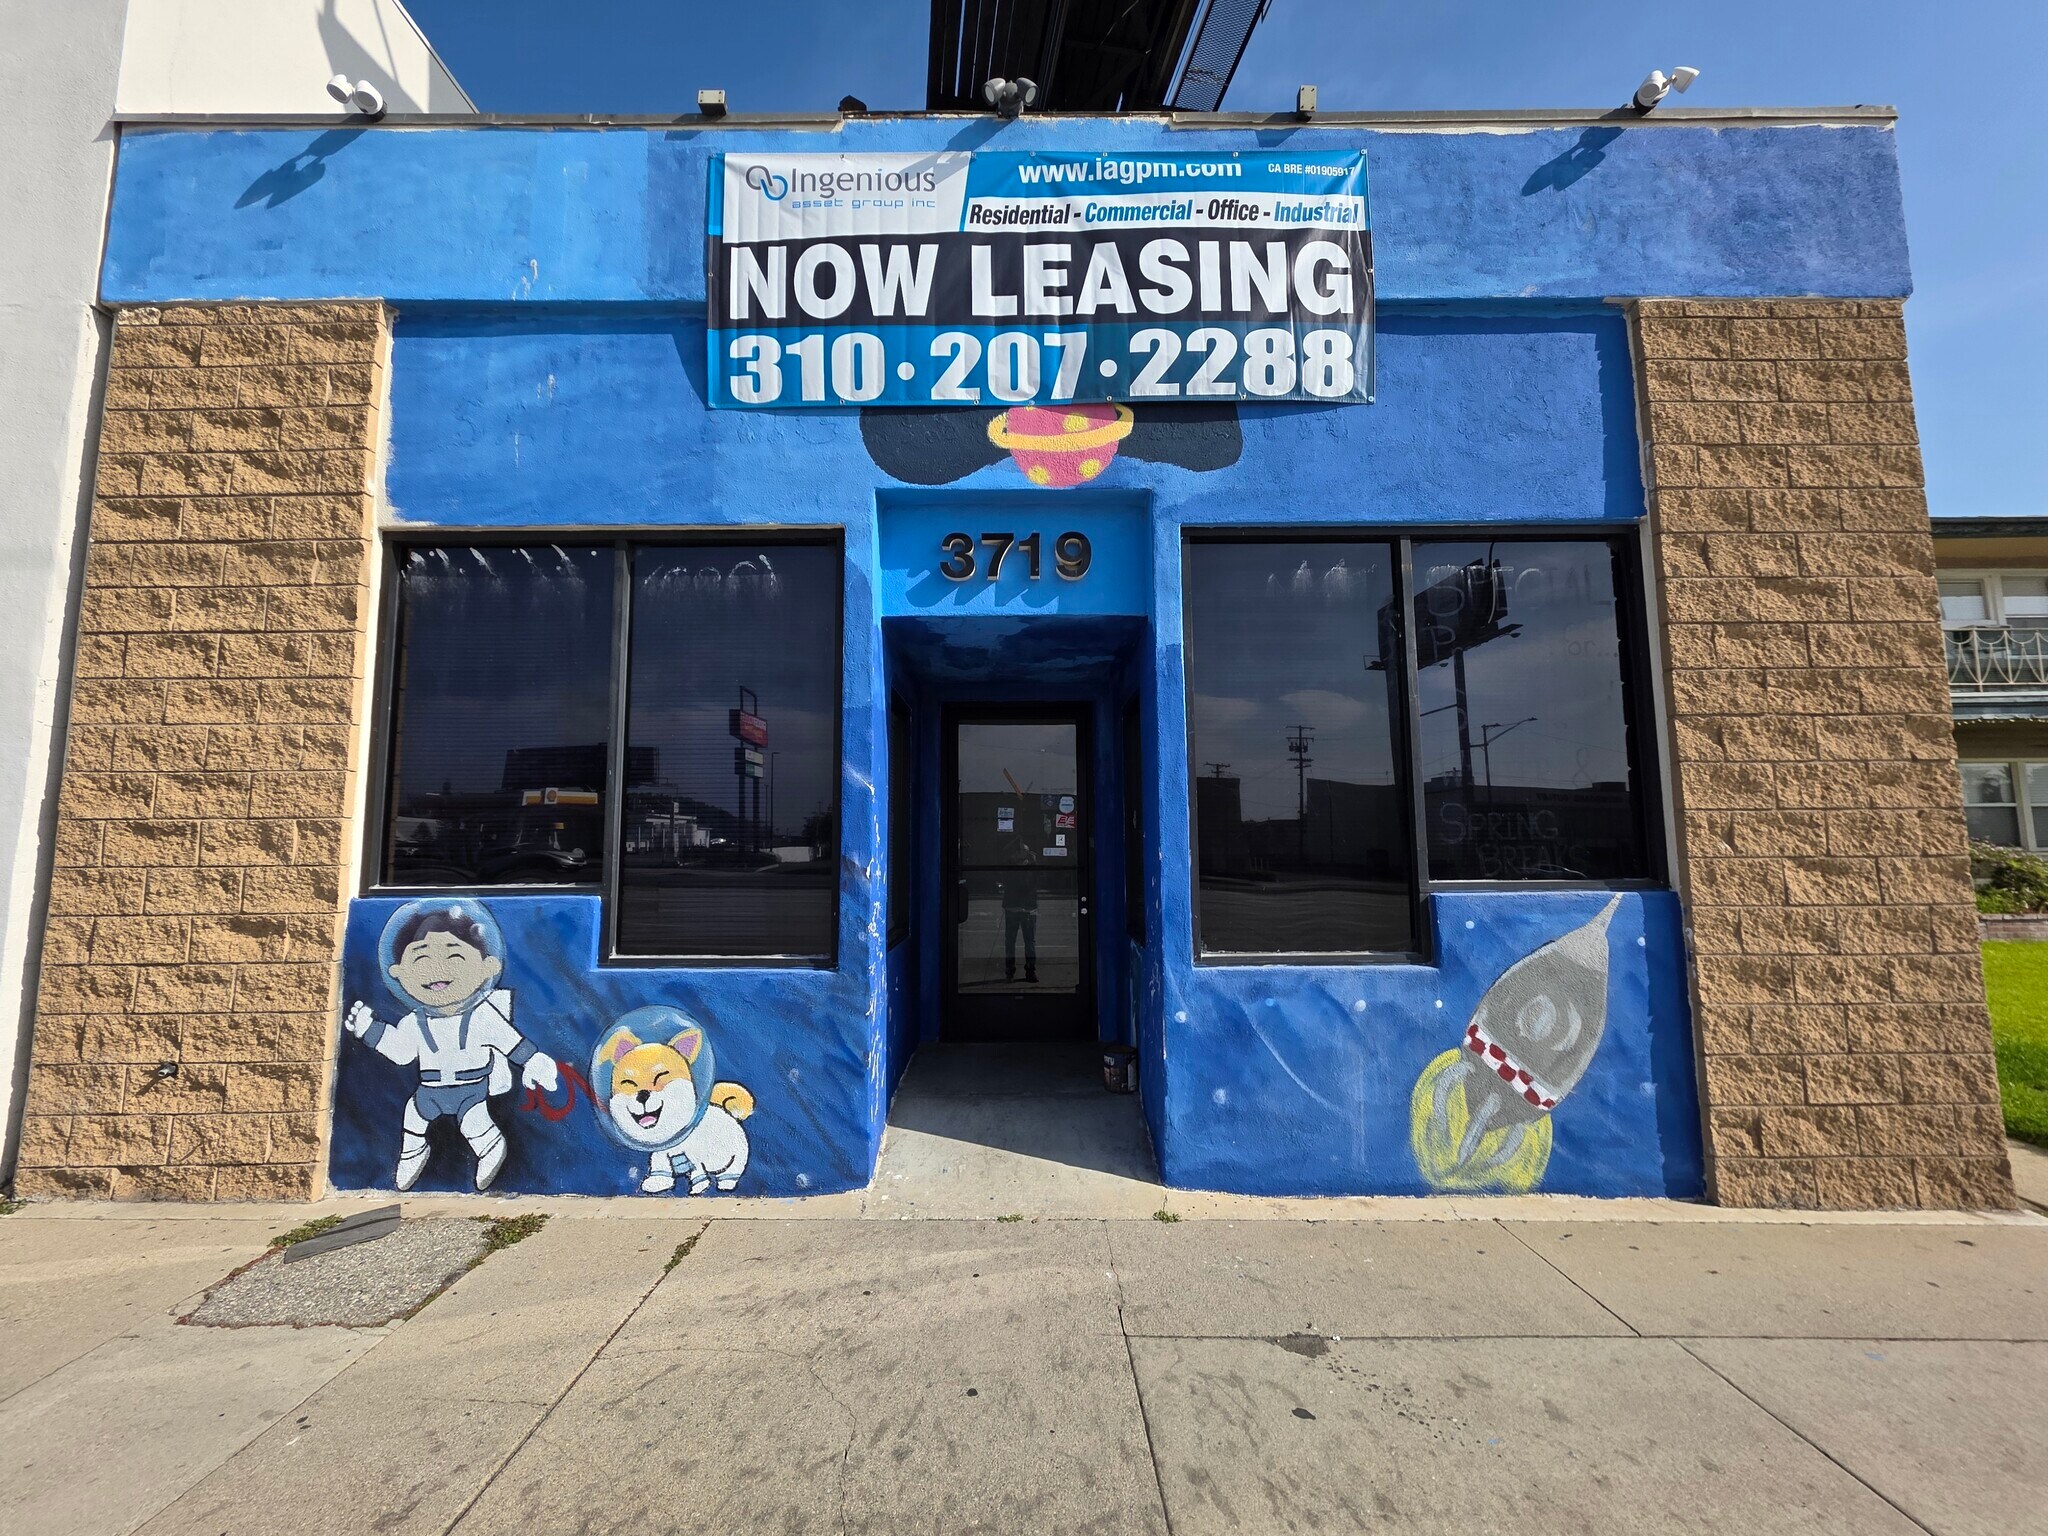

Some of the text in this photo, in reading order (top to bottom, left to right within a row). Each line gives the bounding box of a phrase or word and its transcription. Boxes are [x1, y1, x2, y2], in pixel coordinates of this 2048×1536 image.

[791, 168, 936, 198] Ingenious
[1268, 163, 1355, 176] CA BRE #01905917
[792, 198, 936, 209] asset group inc
[970, 203, 1070, 225] Residential
[1084, 199, 1192, 224] Commercial
[1207, 198, 1259, 223] Office
[1274, 201, 1359, 223] Industrial
[729, 239, 1352, 320] NOW LEASING
[940, 531, 1092, 582] 3719
